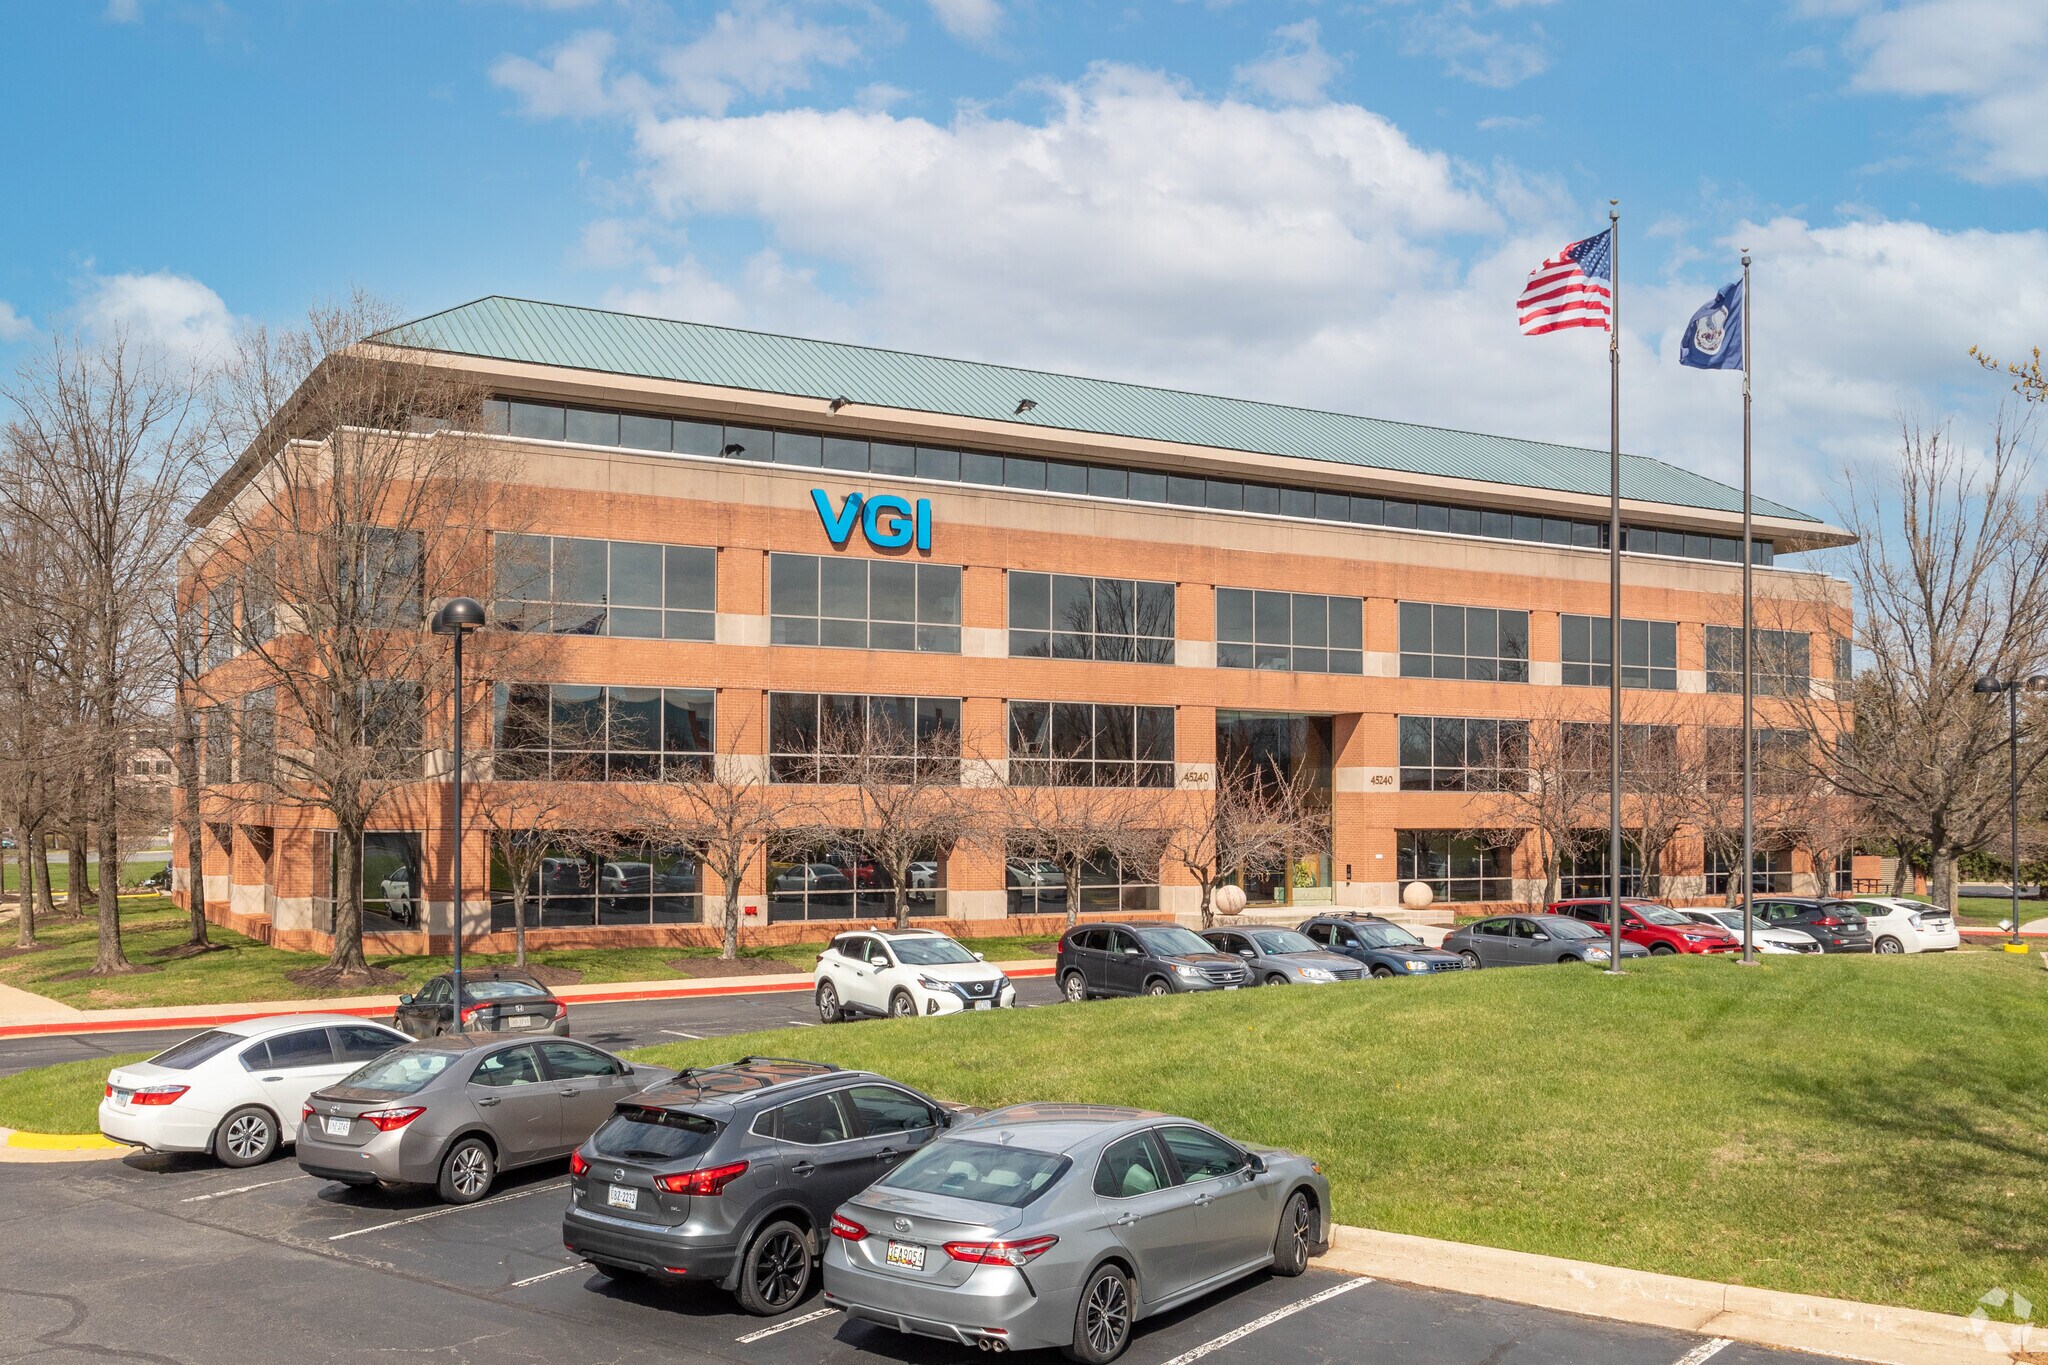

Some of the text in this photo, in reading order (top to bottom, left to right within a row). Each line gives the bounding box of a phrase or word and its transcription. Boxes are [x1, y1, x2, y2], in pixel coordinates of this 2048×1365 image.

[811, 488, 932, 550] VGI
[1183, 772, 1209, 783] 45240
[1370, 775, 1394, 786] 45240
[887, 1245, 924, 1264] 3EA9054
